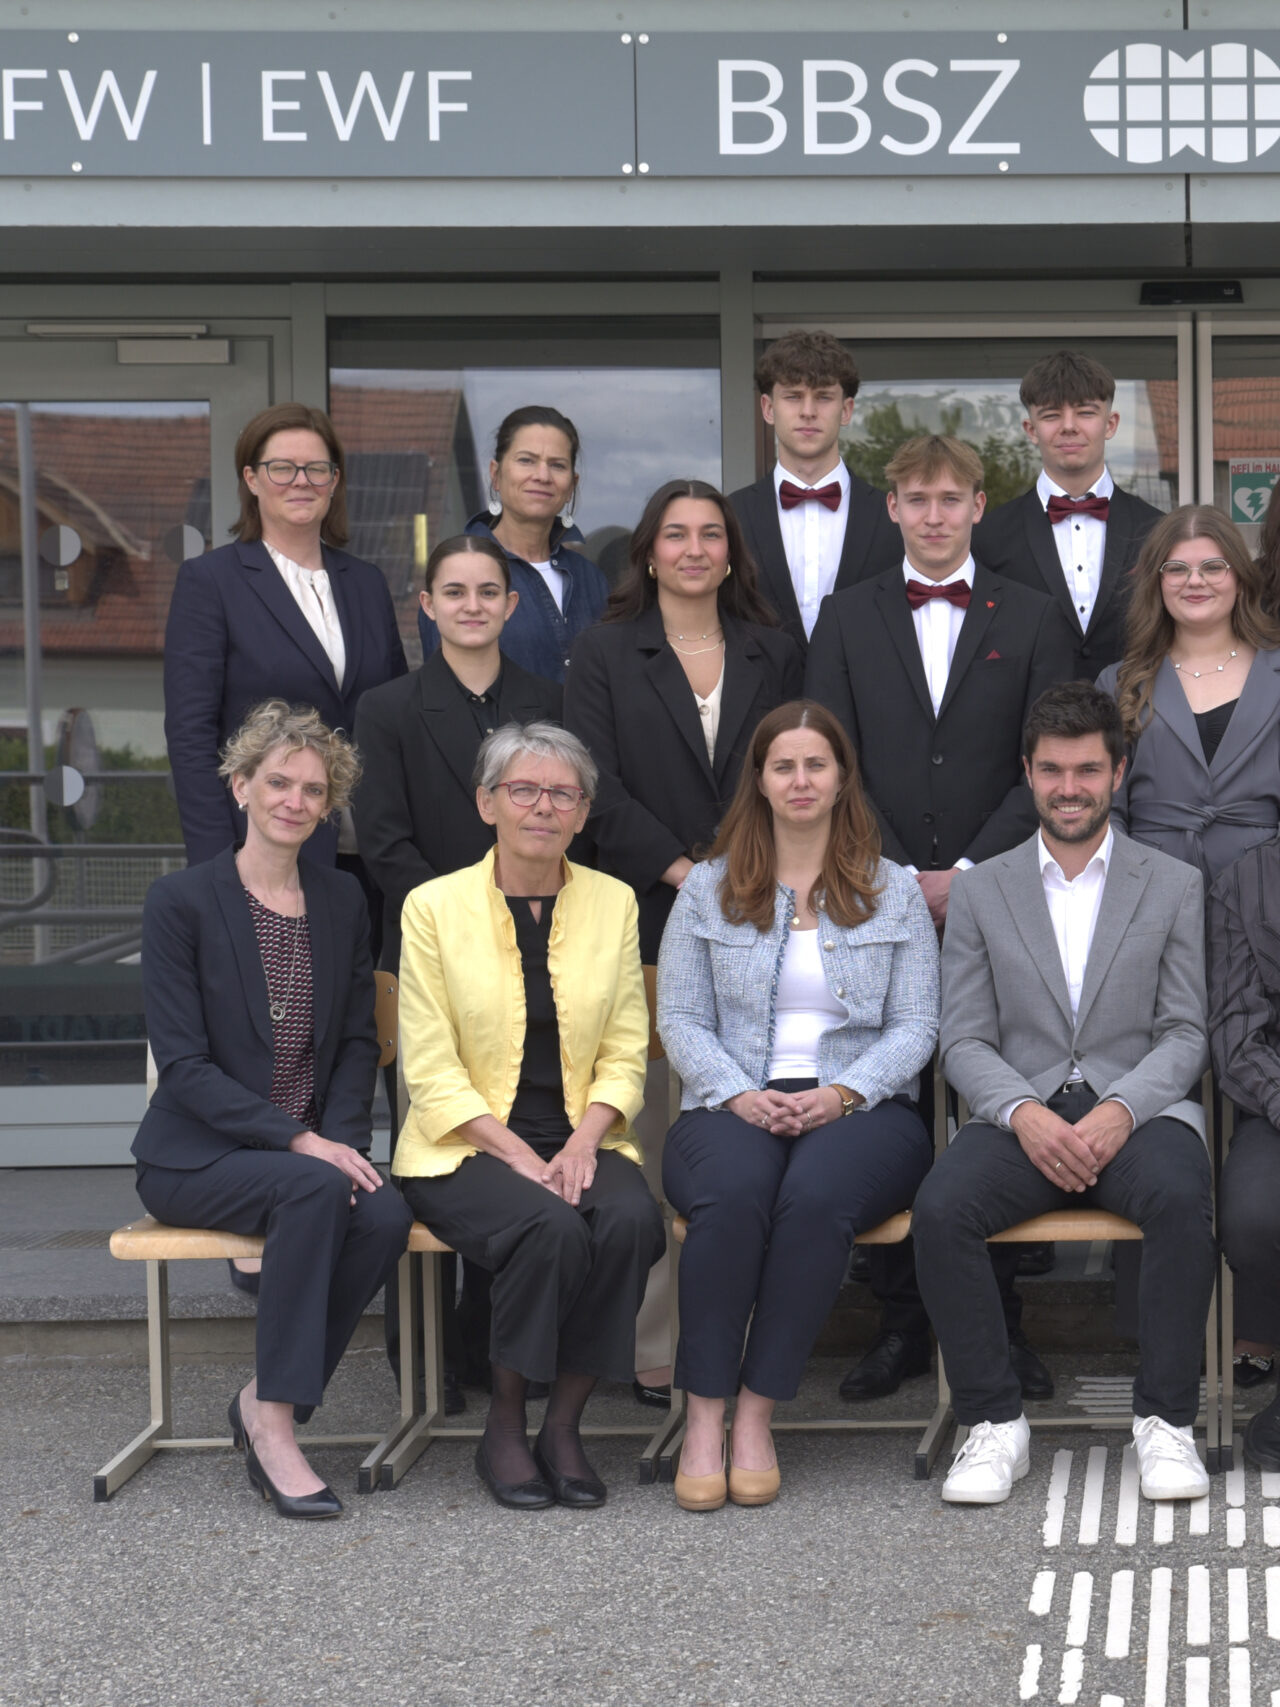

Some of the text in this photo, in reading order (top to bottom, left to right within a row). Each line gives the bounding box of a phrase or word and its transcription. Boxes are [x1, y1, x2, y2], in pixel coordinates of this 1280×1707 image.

[2, 69, 157, 141] FW
[260, 70, 473, 141] EWF
[718, 59, 1021, 156] BBSZ
[1231, 463, 1250, 474] DEFI
[1253, 462, 1263, 473] im
